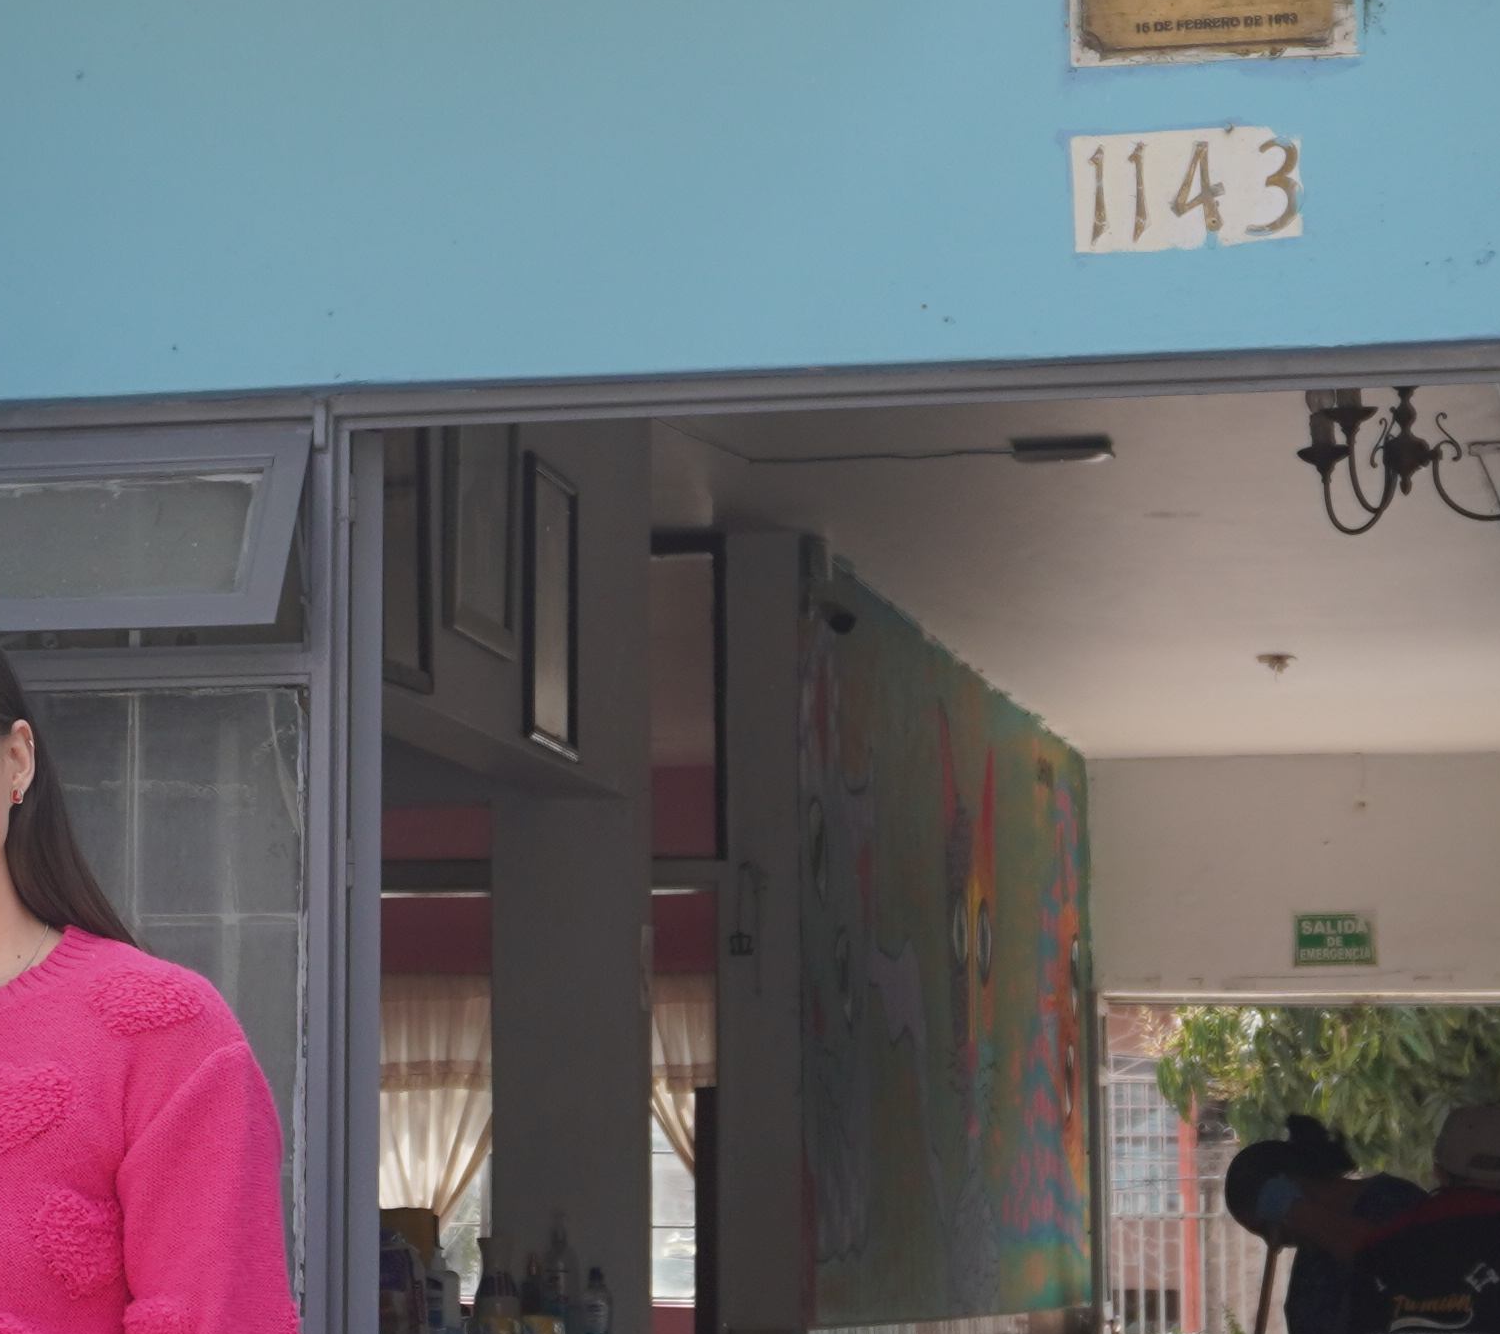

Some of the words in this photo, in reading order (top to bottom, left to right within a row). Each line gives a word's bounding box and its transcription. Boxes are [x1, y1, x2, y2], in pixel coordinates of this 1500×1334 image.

[1176, 15, 1241, 31] FEBRERO
[1089, 139, 1298, 244] 1143
[1300, 918, 1370, 935] SALIDA
[1326, 935, 1344, 947] DE
[1299, 947, 1371, 961] EMERGENCIA
